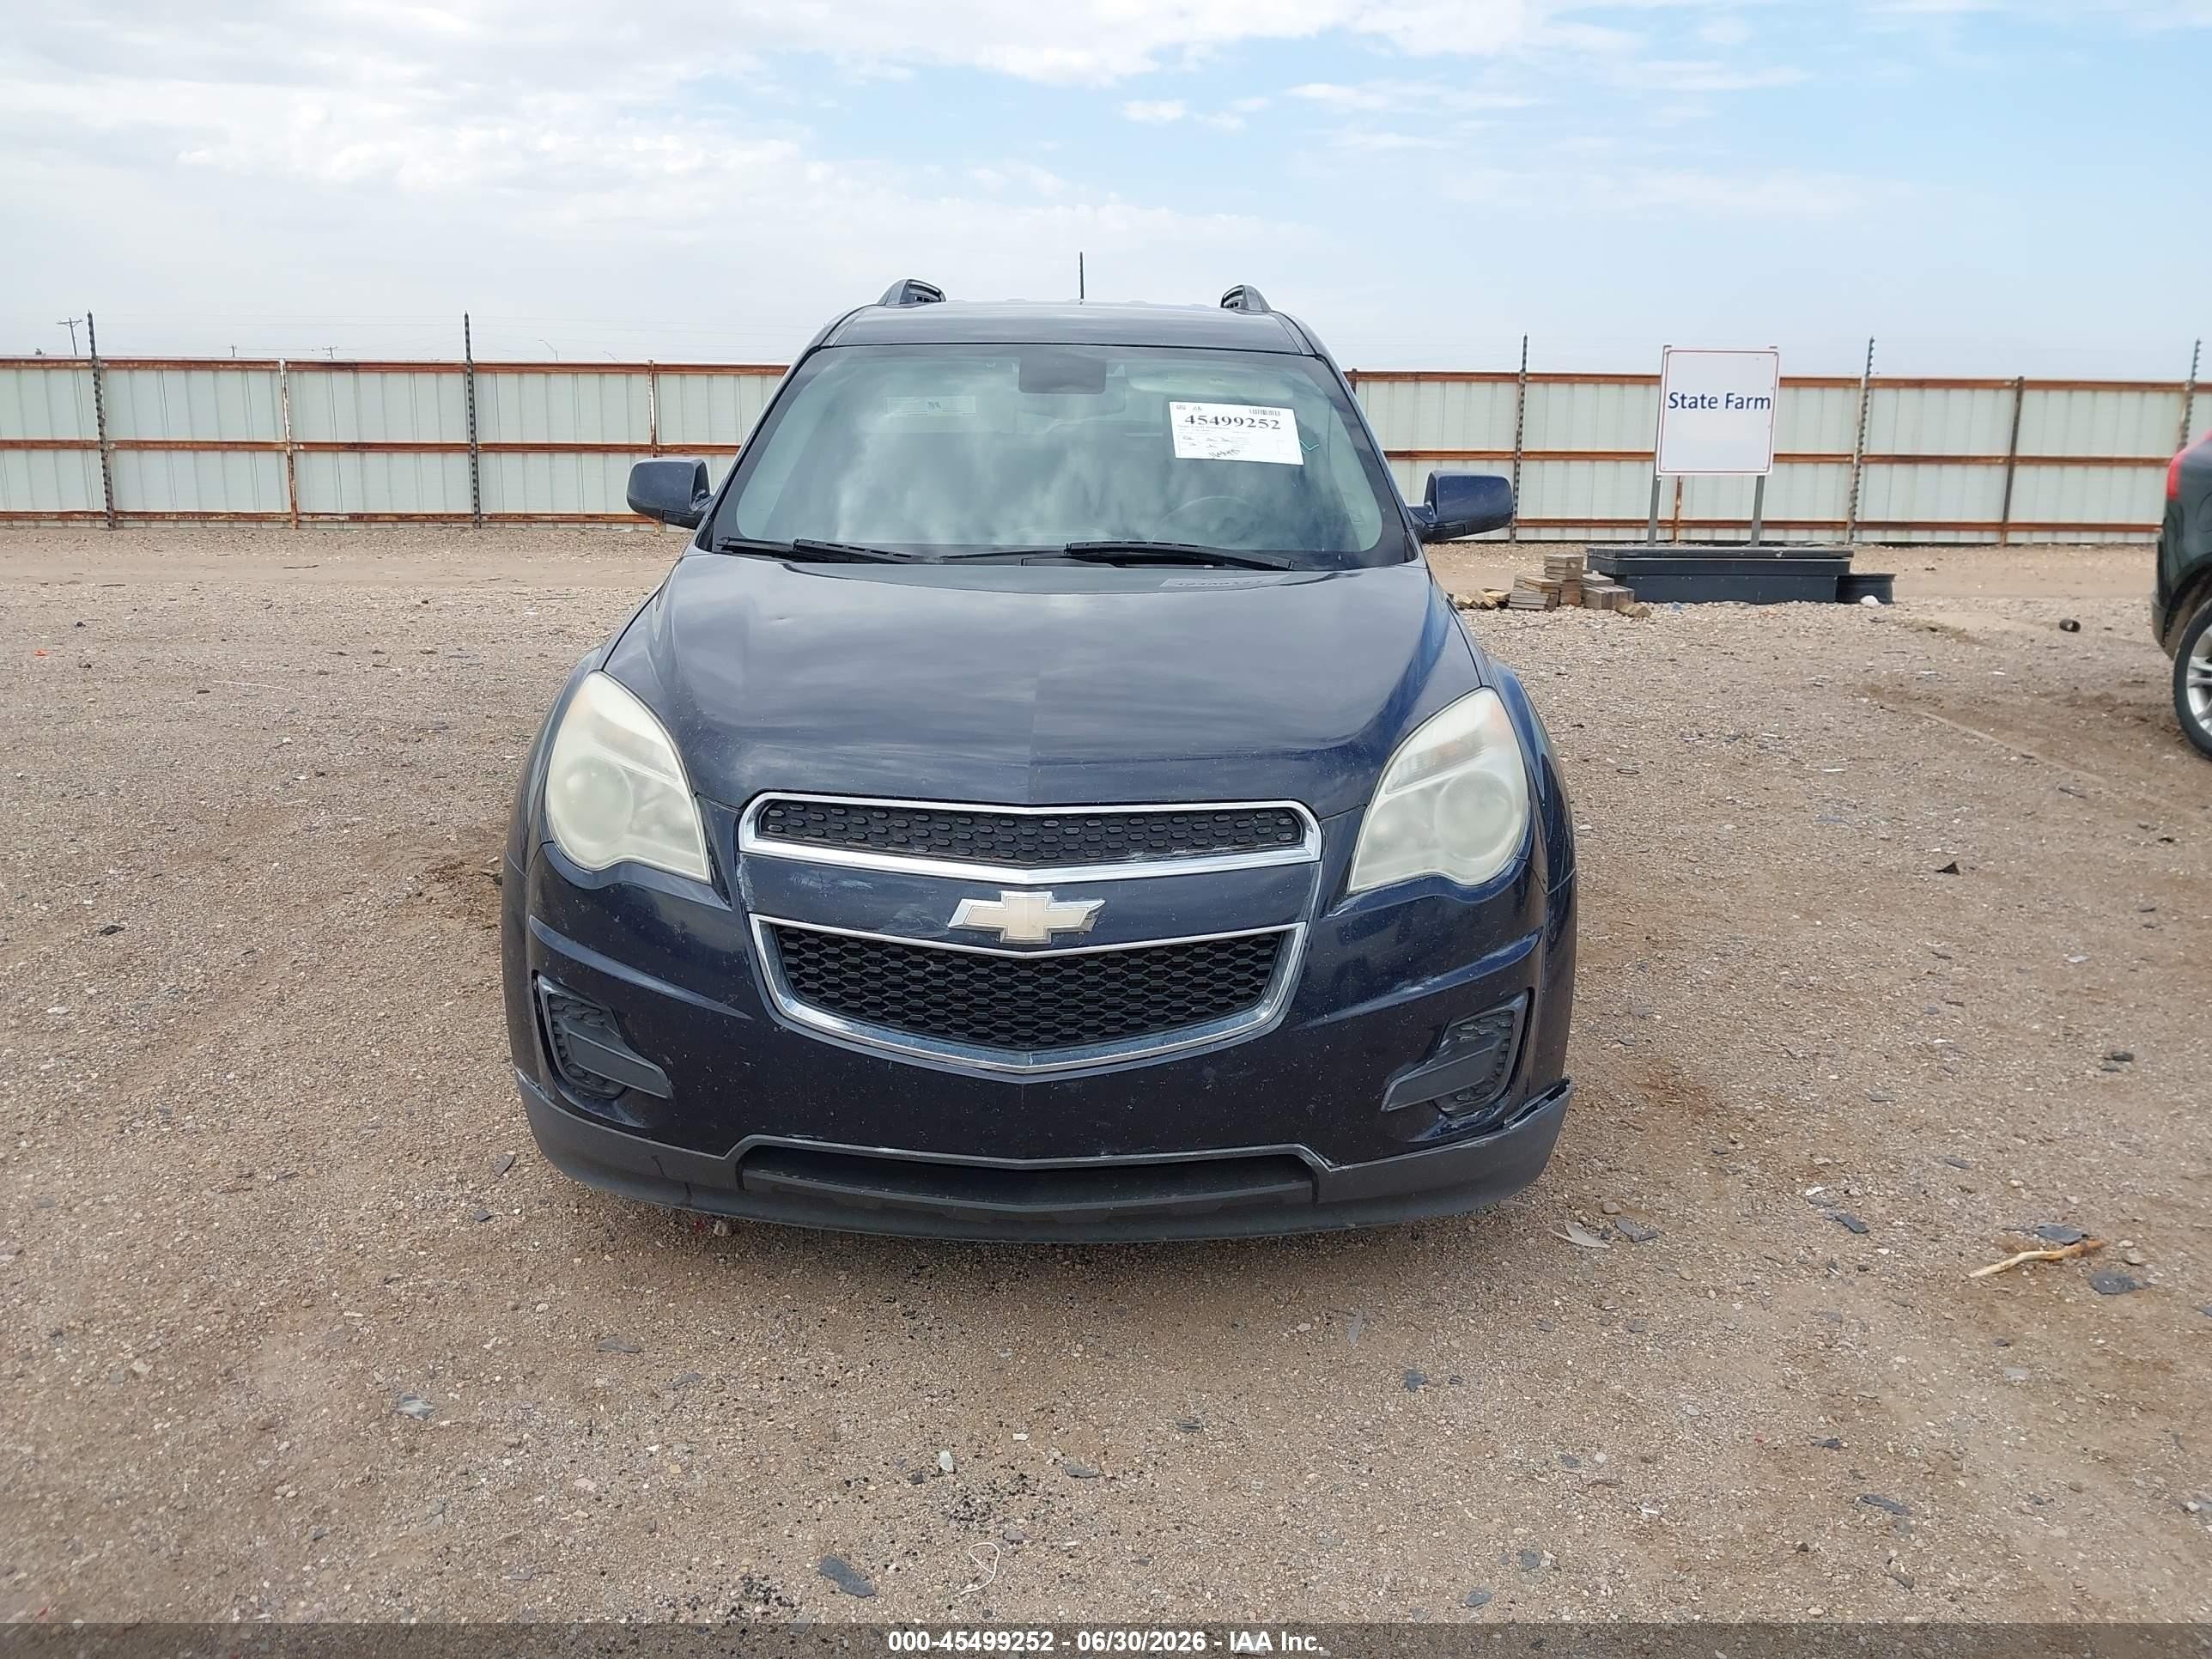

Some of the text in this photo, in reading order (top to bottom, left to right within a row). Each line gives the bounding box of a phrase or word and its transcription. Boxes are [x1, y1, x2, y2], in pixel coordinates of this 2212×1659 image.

[1668, 392, 1771, 410] State Farm
[1184, 414, 1281, 430] 45499252
